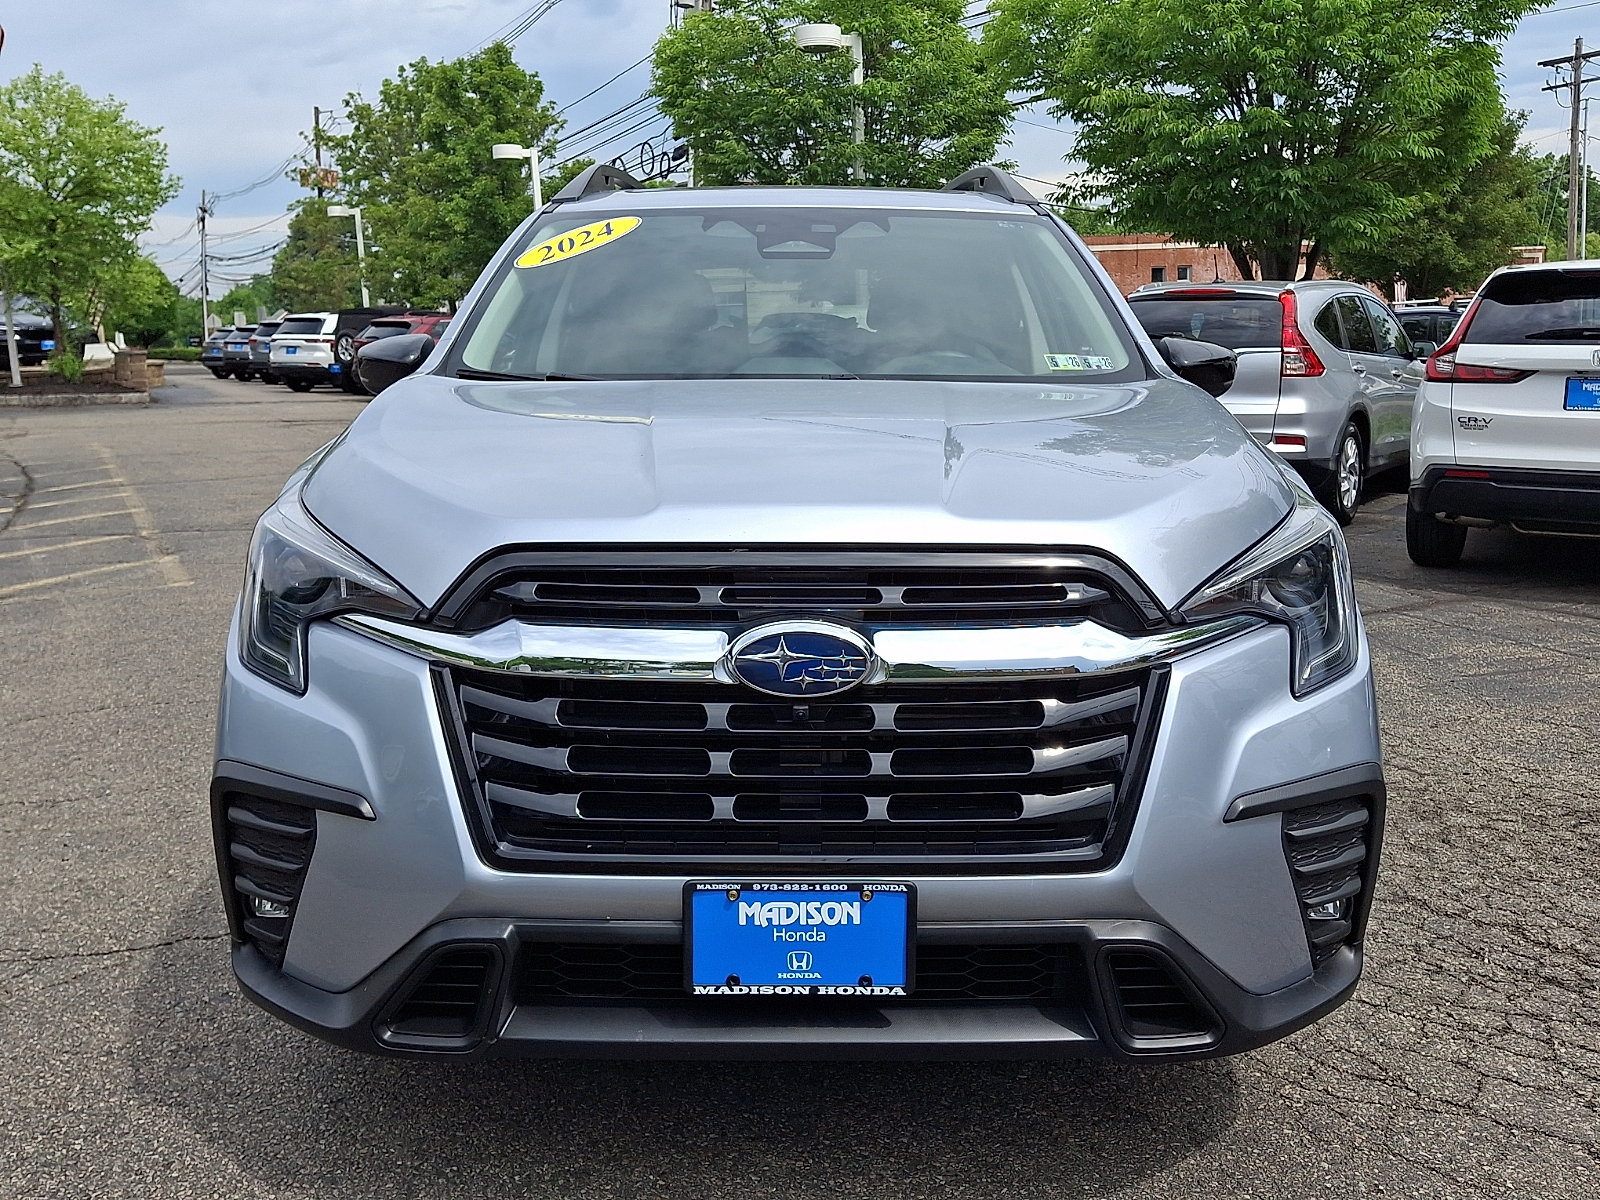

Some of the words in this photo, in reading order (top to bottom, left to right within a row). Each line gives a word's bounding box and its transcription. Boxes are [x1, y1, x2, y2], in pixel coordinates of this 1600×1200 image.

[537, 221, 615, 263] 2024
[1457, 416, 1493, 425] CR-V
[696, 883, 742, 891] MADISON
[752, 883, 848, 891] 973-822-1600
[862, 883, 908, 892] HONDA
[738, 901, 861, 928] MADISON
[773, 927, 826, 942] Honda
[693, 985, 811, 995] MADISON
[817, 985, 907, 996] HONDA
